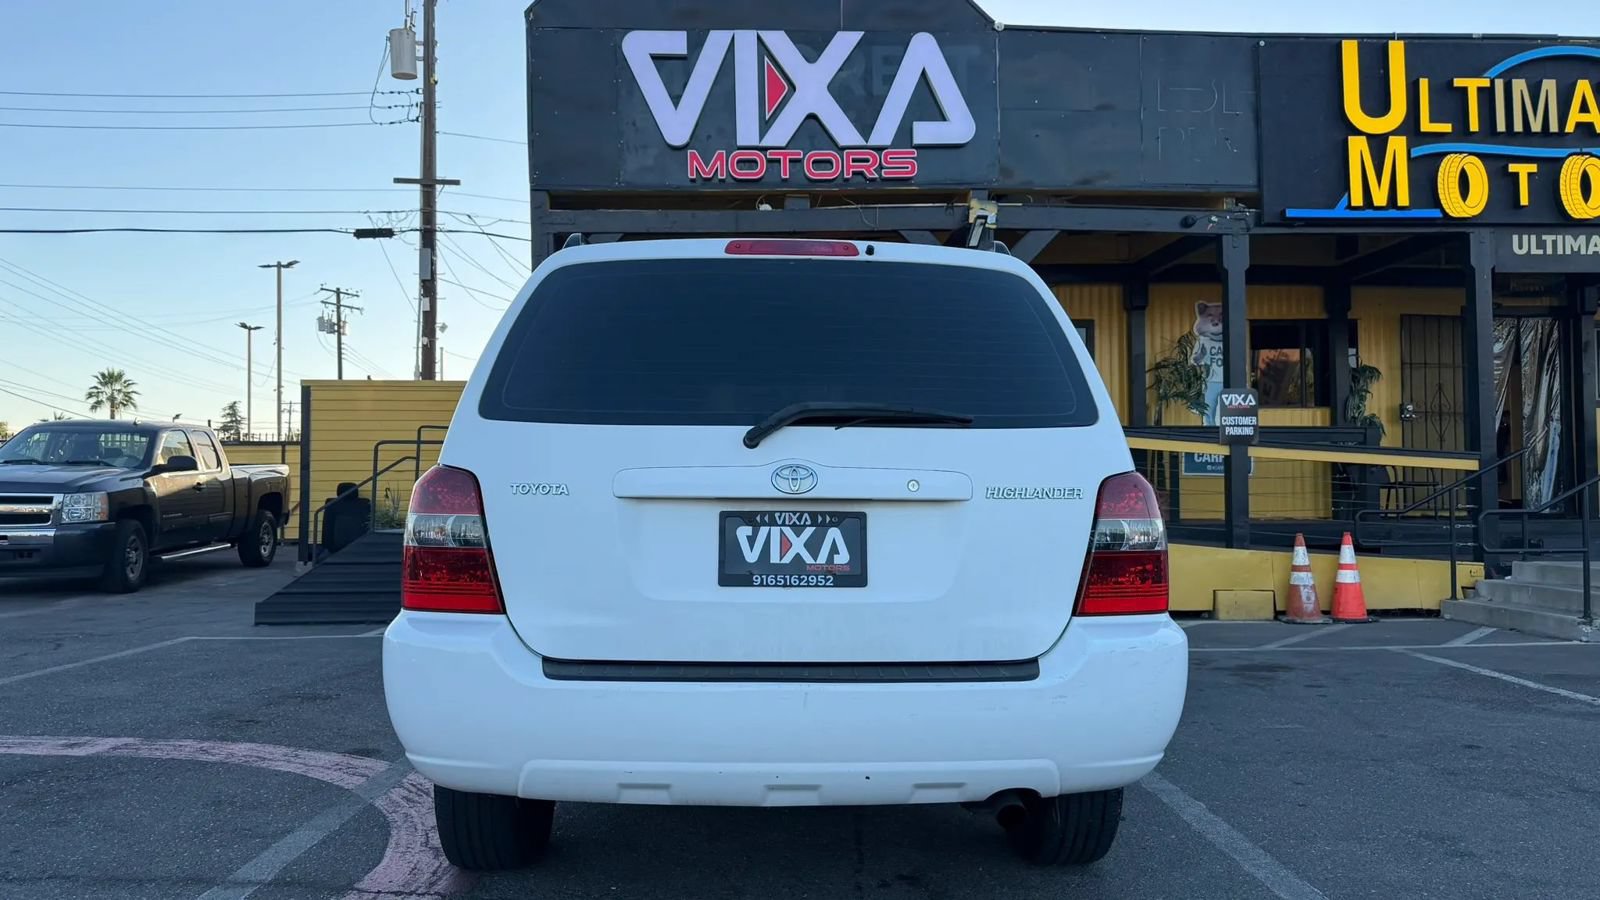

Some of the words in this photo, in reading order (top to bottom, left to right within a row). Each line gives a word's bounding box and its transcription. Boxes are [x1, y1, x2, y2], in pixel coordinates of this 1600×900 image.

[622, 30, 976, 148] VIXA
[1341, 40, 1600, 134] ULTIMA
[687, 150, 918, 180] MOTORS
[1512, 234, 1600, 255] ULTIMA
[1221, 394, 1256, 406] VIXA
[1222, 416, 1257, 426] CUSTOMER
[1225, 426, 1254, 436] PARKING
[510, 482, 570, 496] TOYOTA
[985, 486, 1083, 500] HIGHLANDER
[775, 512, 812, 525] VIXA
[735, 526, 851, 564] VIXA
[806, 564, 851, 572] MOTORS
[752, 575, 834, 586] 9165162952
